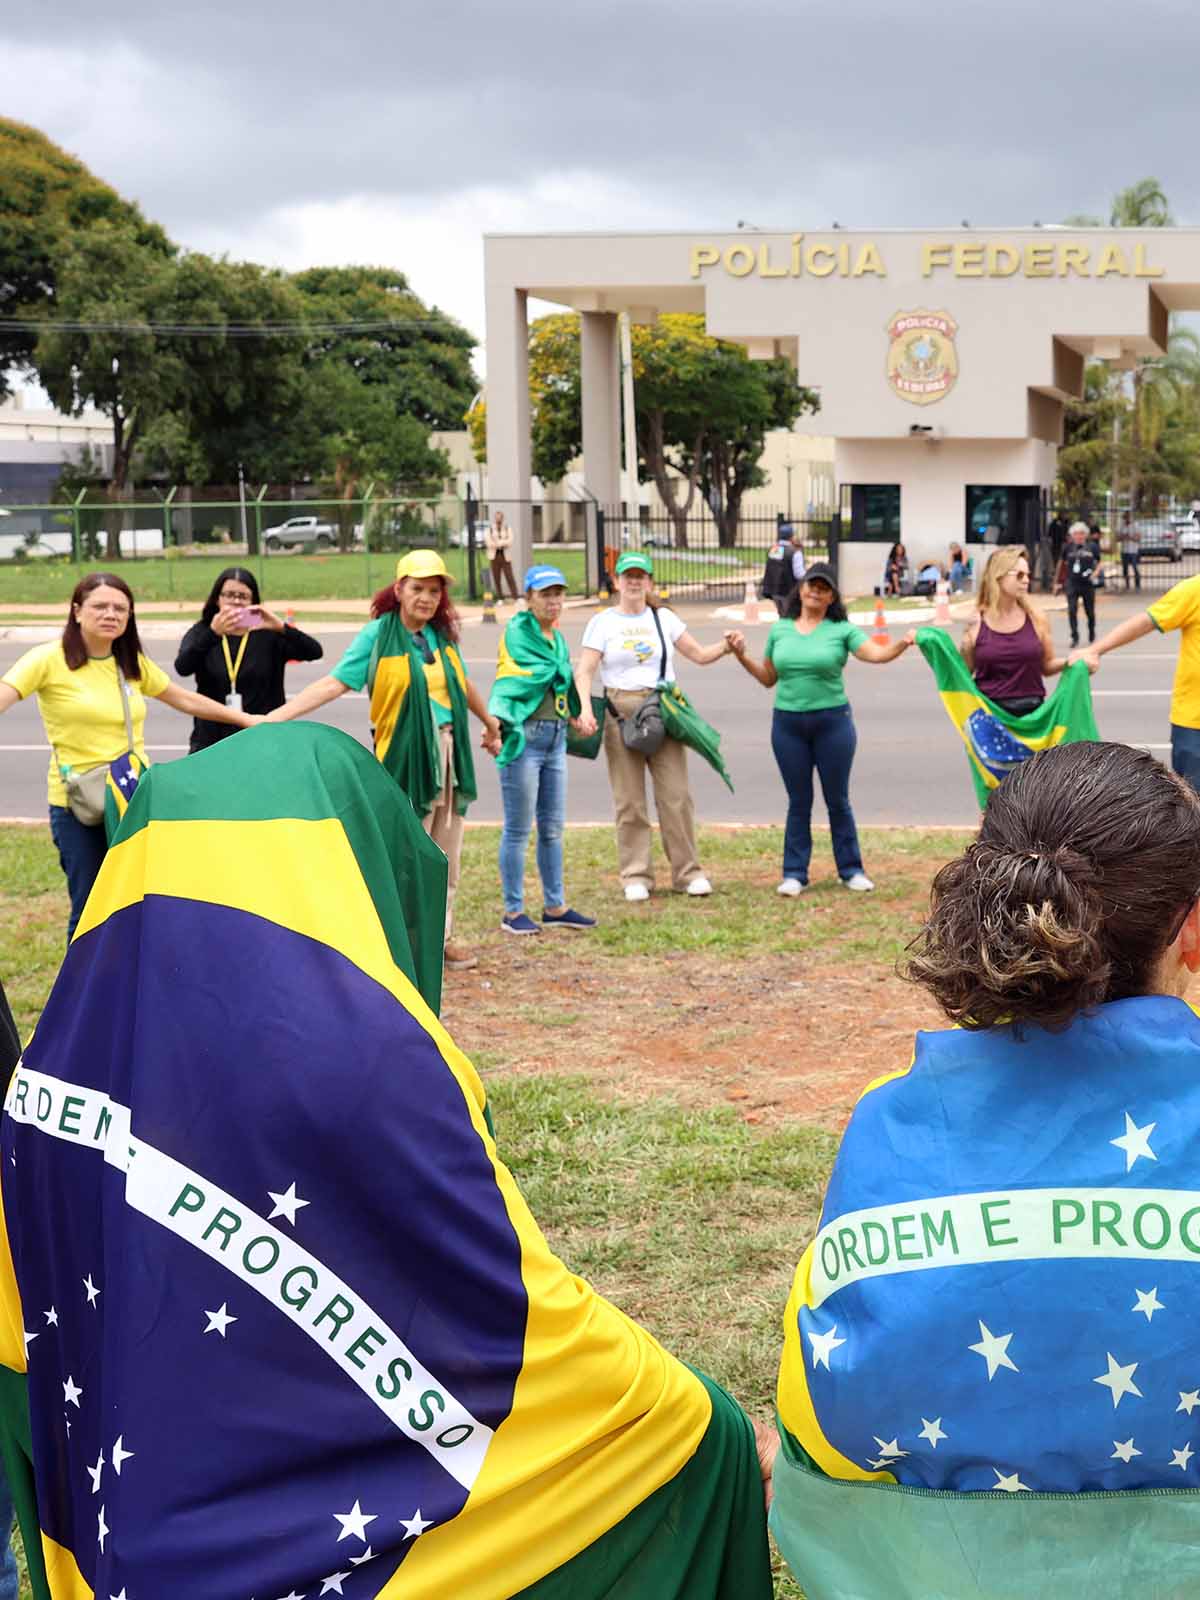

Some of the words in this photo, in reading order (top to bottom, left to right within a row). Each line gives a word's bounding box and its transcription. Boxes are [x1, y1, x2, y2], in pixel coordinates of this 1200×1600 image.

[688, 233, 887, 278] POLÍCIA
[921, 242, 1165, 278] FEDERAL
[9, 1072, 113, 1141] RDE
[167, 1182, 475, 1448] PROGRESSO
[820, 1208, 960, 1282] ORDEM
[982, 1199, 1019, 1247] E
